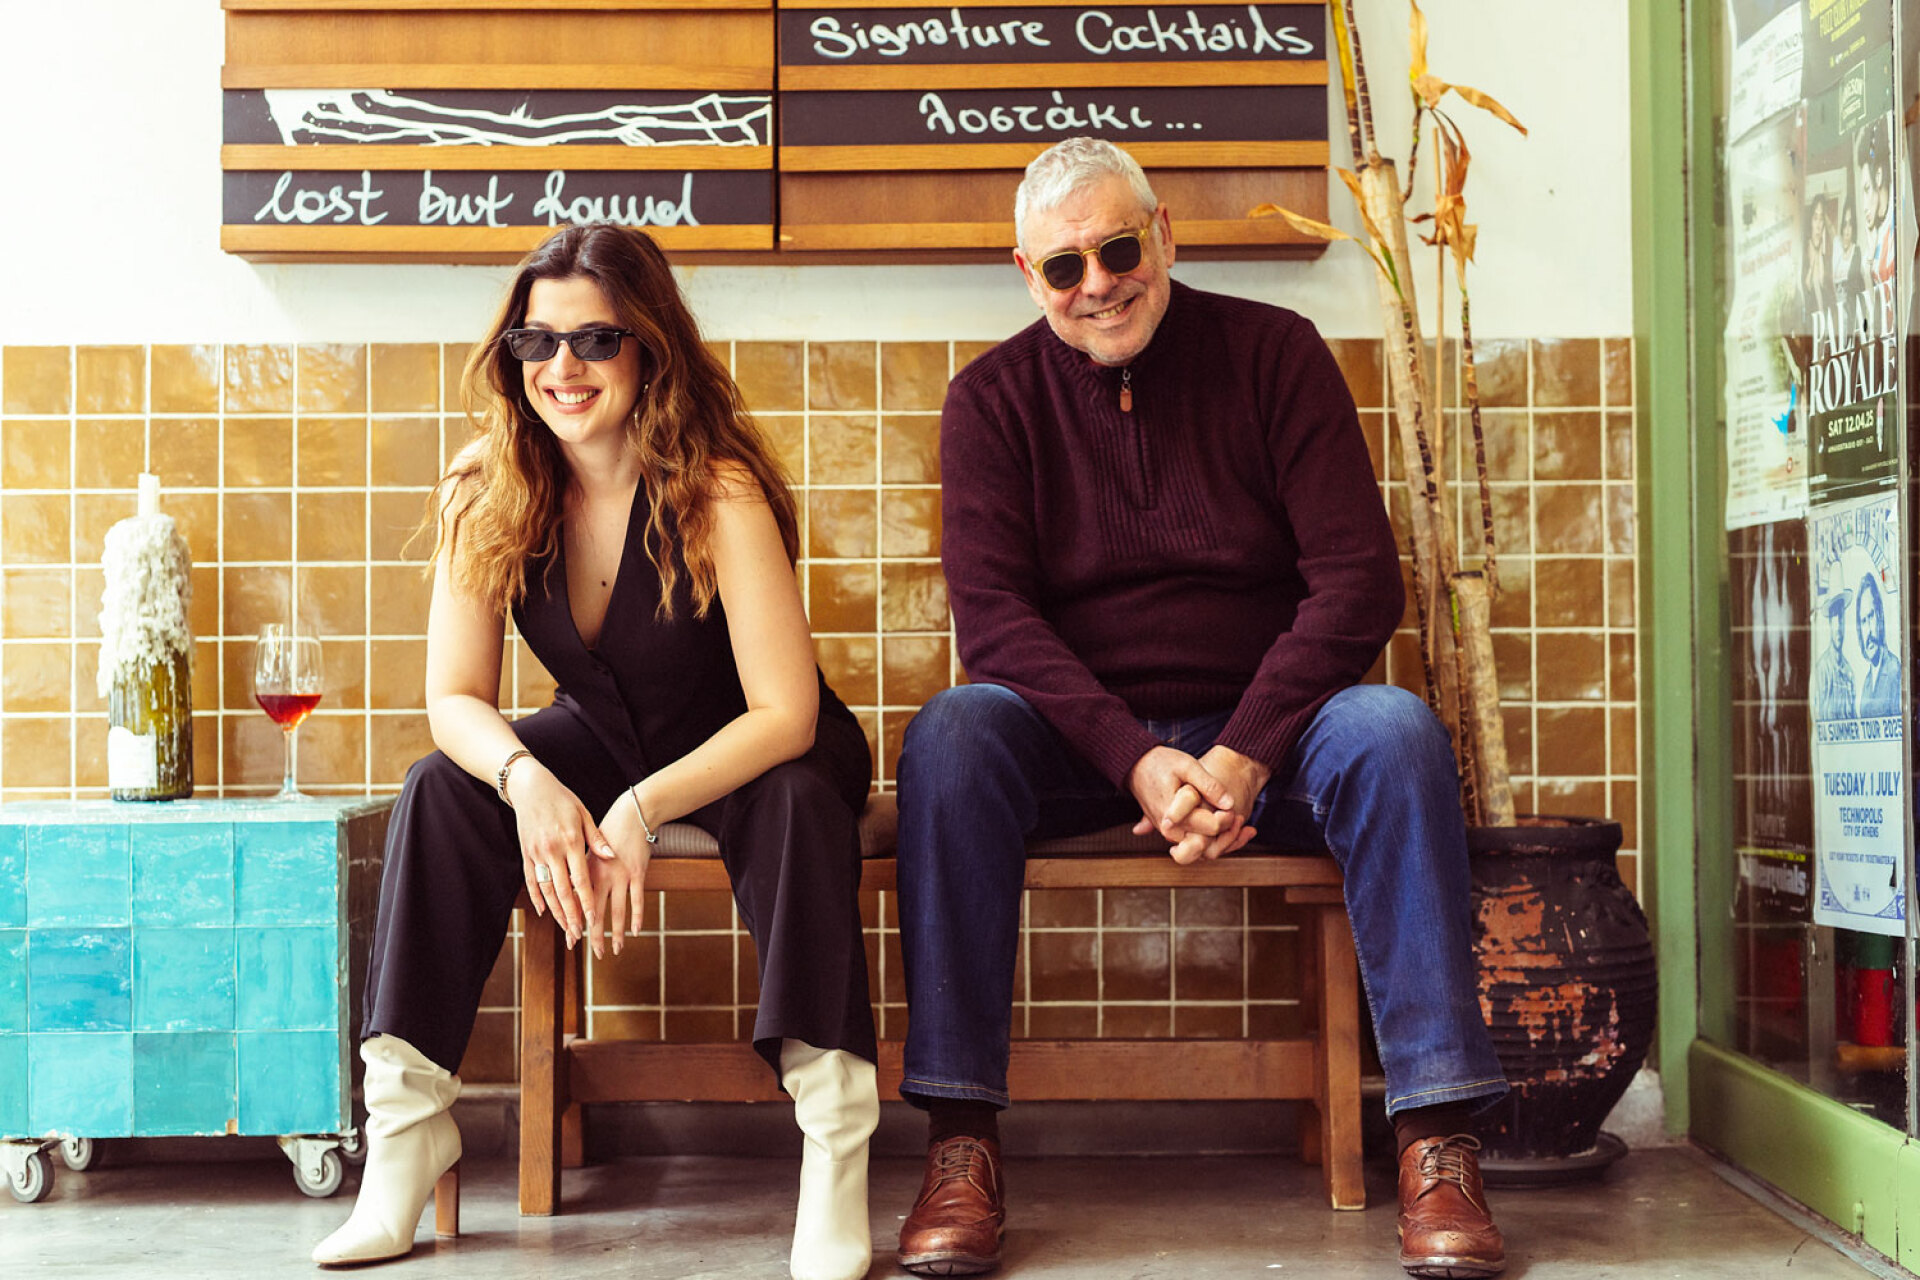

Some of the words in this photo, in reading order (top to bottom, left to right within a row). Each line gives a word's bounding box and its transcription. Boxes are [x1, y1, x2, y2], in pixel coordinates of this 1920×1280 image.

[811, 10, 1050, 57] Signature
[1077, 6, 1313, 54] Cocktails
[254, 170, 388, 224] lost
[419, 170, 514, 226] but
[533, 170, 700, 227] found
[1811, 282, 1896, 363] PALAYE
[1809, 337, 1897, 416] ROYALE
[1828, 418, 1843, 437] SAT
[1845, 410, 1874, 433] 12.04.25
[1828, 721, 1859, 741] SUMMER
[1861, 720, 1880, 739] TOUR
[1882, 718, 1902, 738] 2025
[1876, 771, 1900, 796] JULY
[1839, 807, 1883, 824] TECHNOPOLIS
